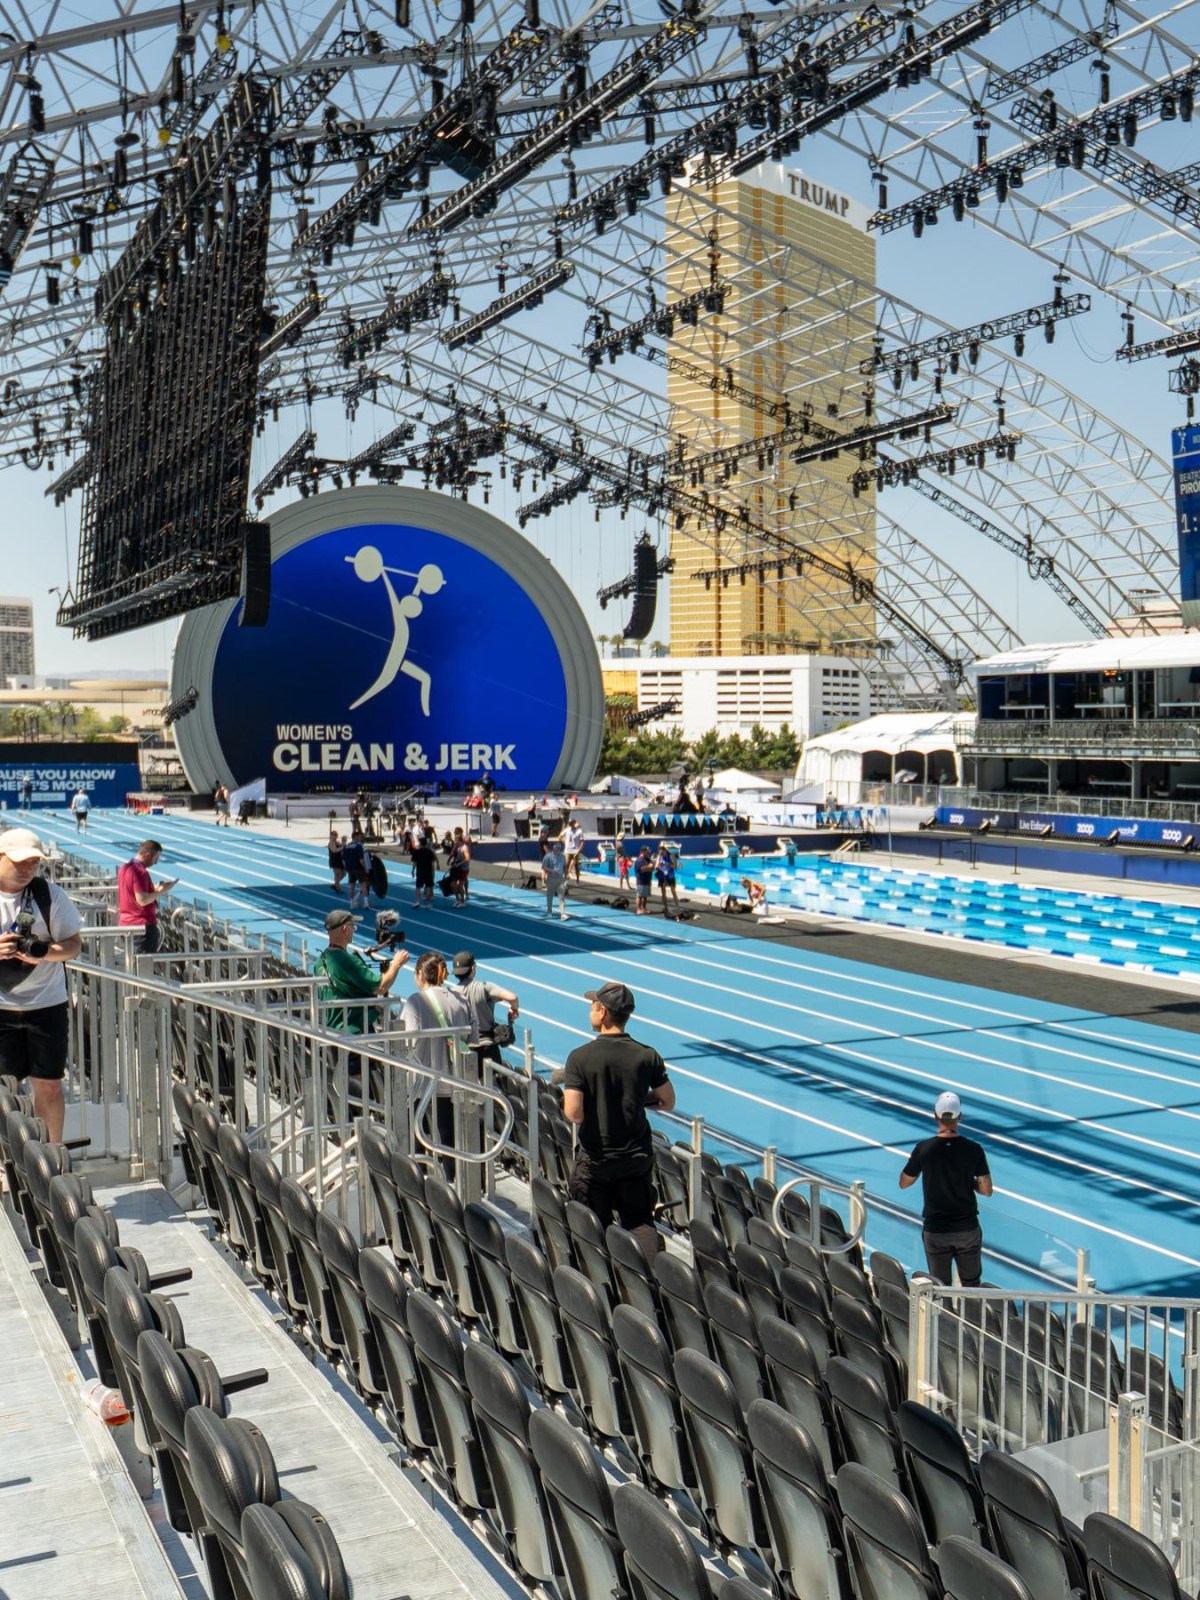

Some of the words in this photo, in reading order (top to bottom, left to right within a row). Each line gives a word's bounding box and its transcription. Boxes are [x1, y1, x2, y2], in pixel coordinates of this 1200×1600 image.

[787, 173, 849, 217] TRUMP
[277, 725, 352, 740] WOMEN'S
[273, 743, 395, 771] CLEAN
[403, 743, 429, 771] &
[435, 744, 517, 771] JERK
[36, 769, 67, 780] YOU
[69, 769, 116, 780] KNOW
[52, 780, 95, 791] MORE
[1030, 820, 1055, 832] Enhad
[1077, 823, 1094, 835] zoop
[1162, 829, 1182, 842] zoop
